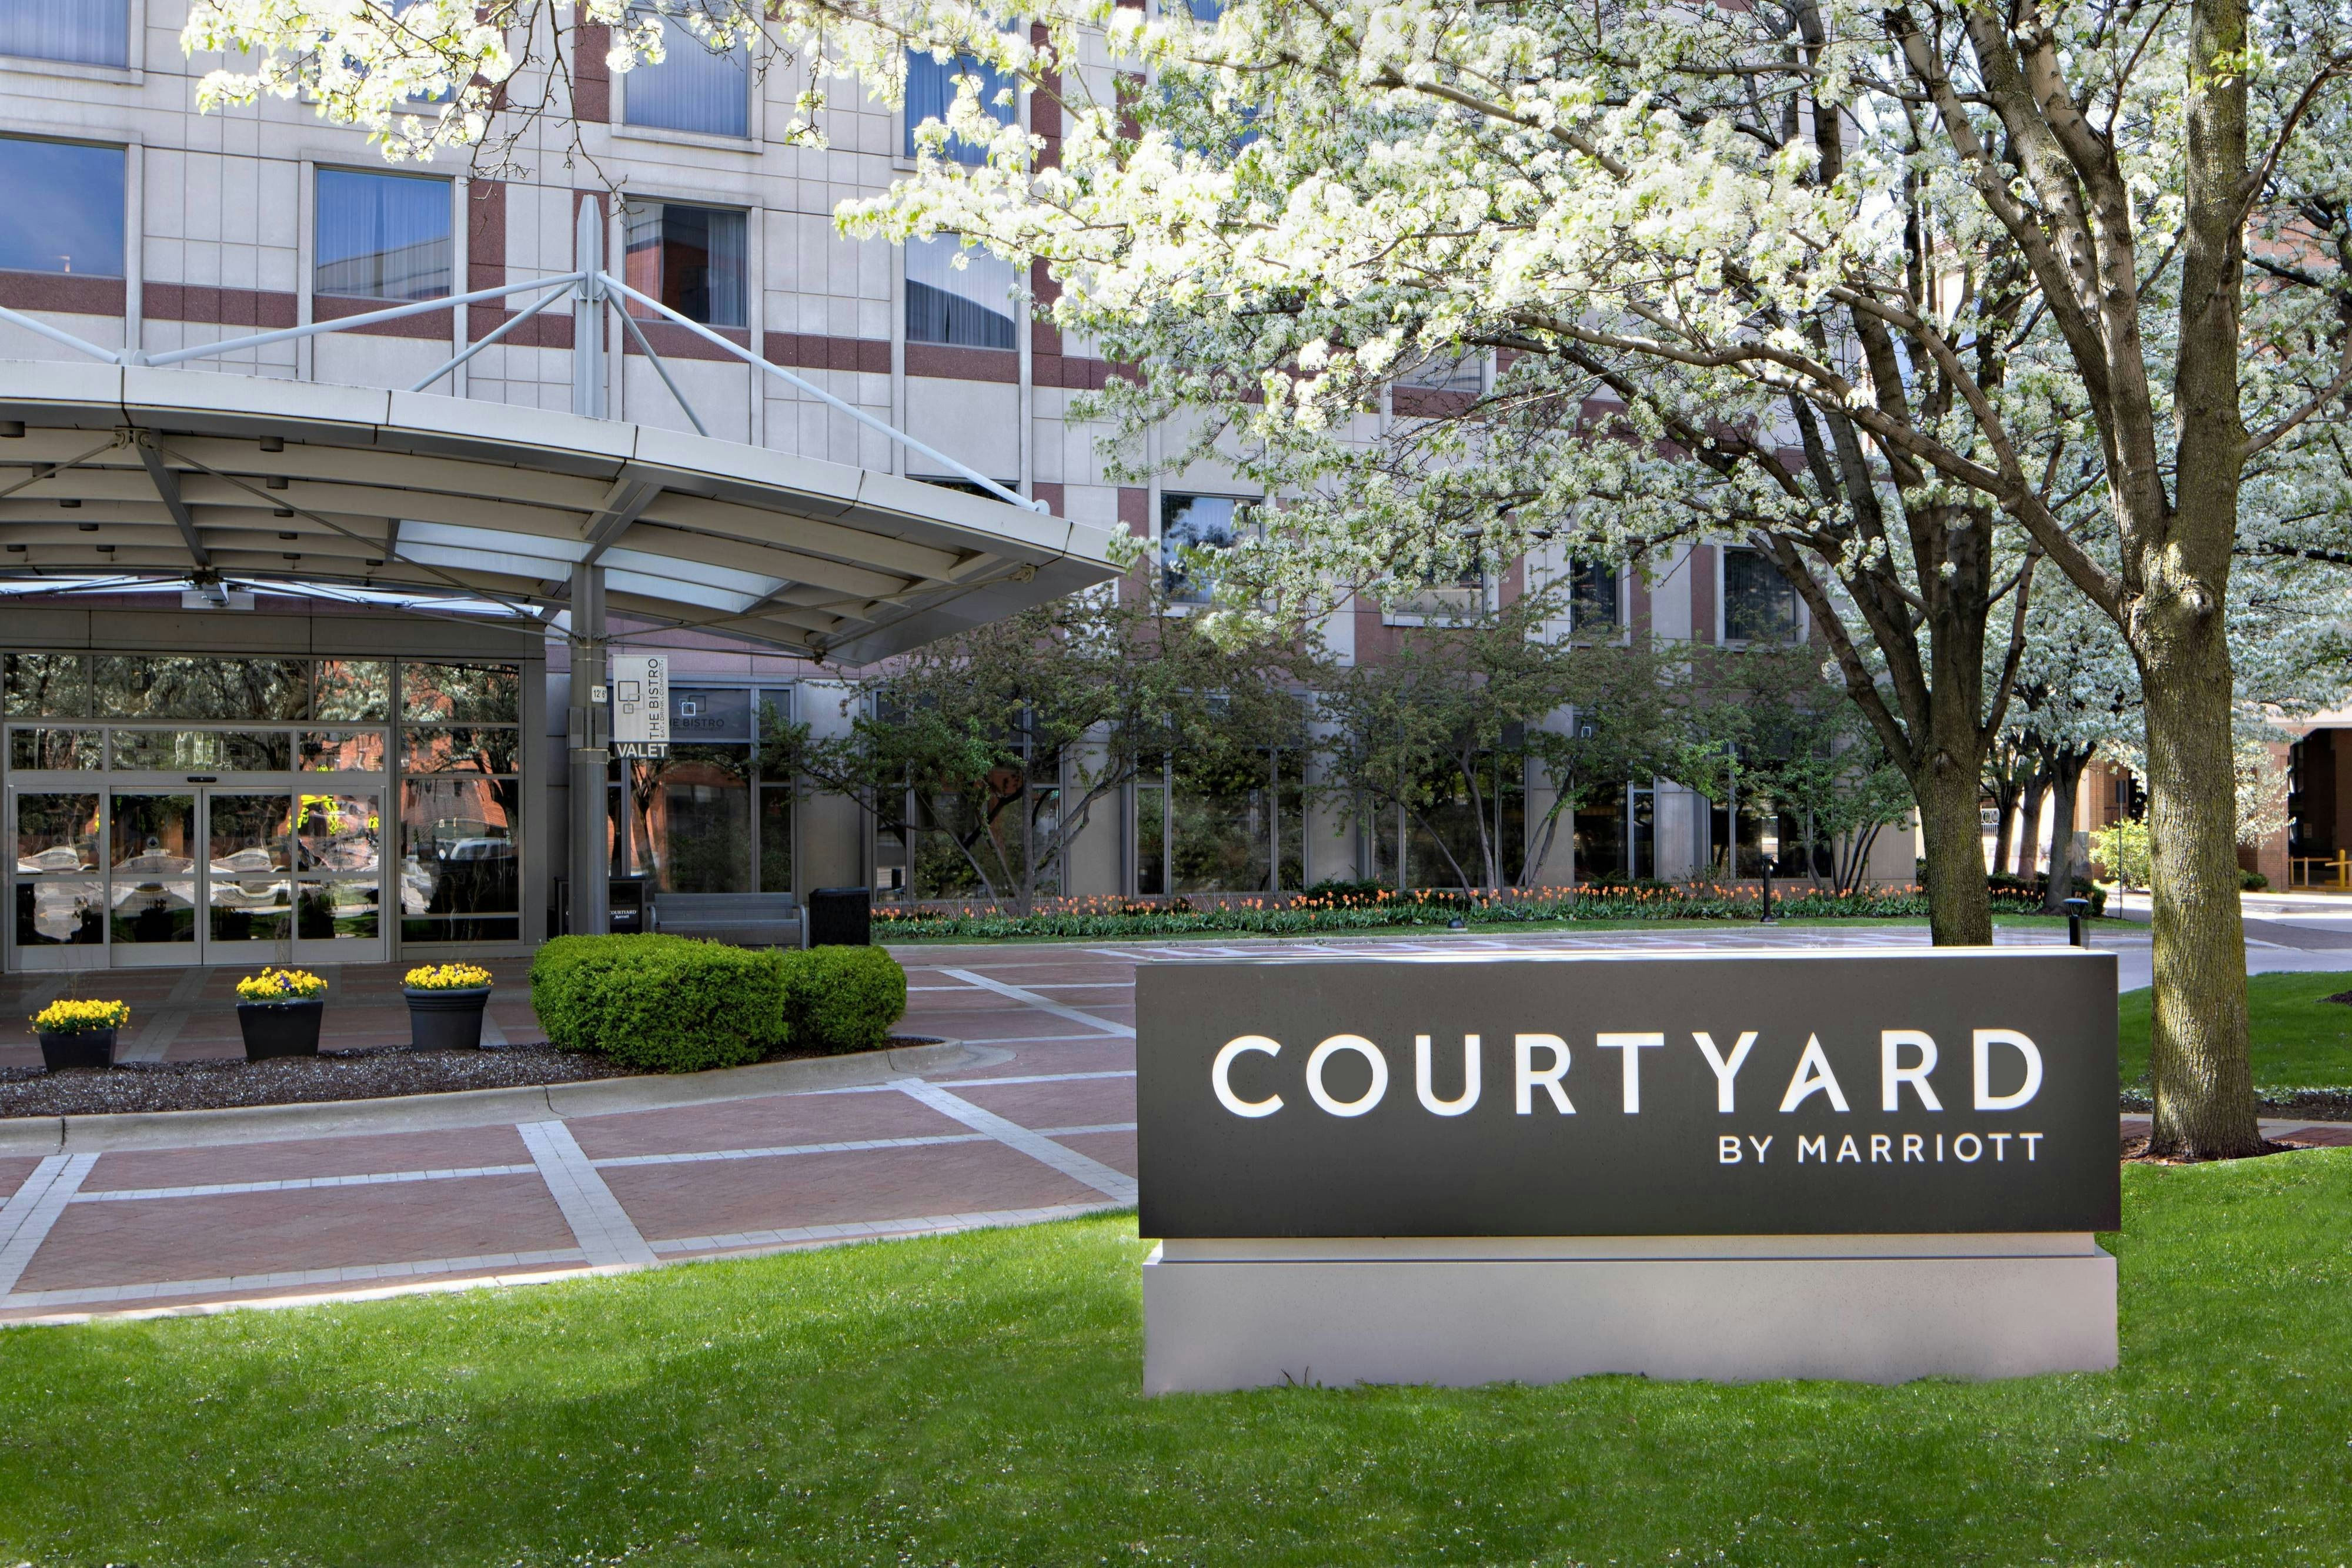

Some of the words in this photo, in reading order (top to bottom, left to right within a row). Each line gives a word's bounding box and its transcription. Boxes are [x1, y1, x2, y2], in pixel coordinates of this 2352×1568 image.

[649, 658, 659, 708] BISTRO
[649, 713, 659, 740] THE
[683, 718, 724, 727] BISTRO
[617, 743, 668, 758] VALET
[1211, 1029, 2043, 1118] COURTYARD
[1719, 1135, 1773, 1164] BY
[1798, 1132, 2043, 1163] MARRIOTT
